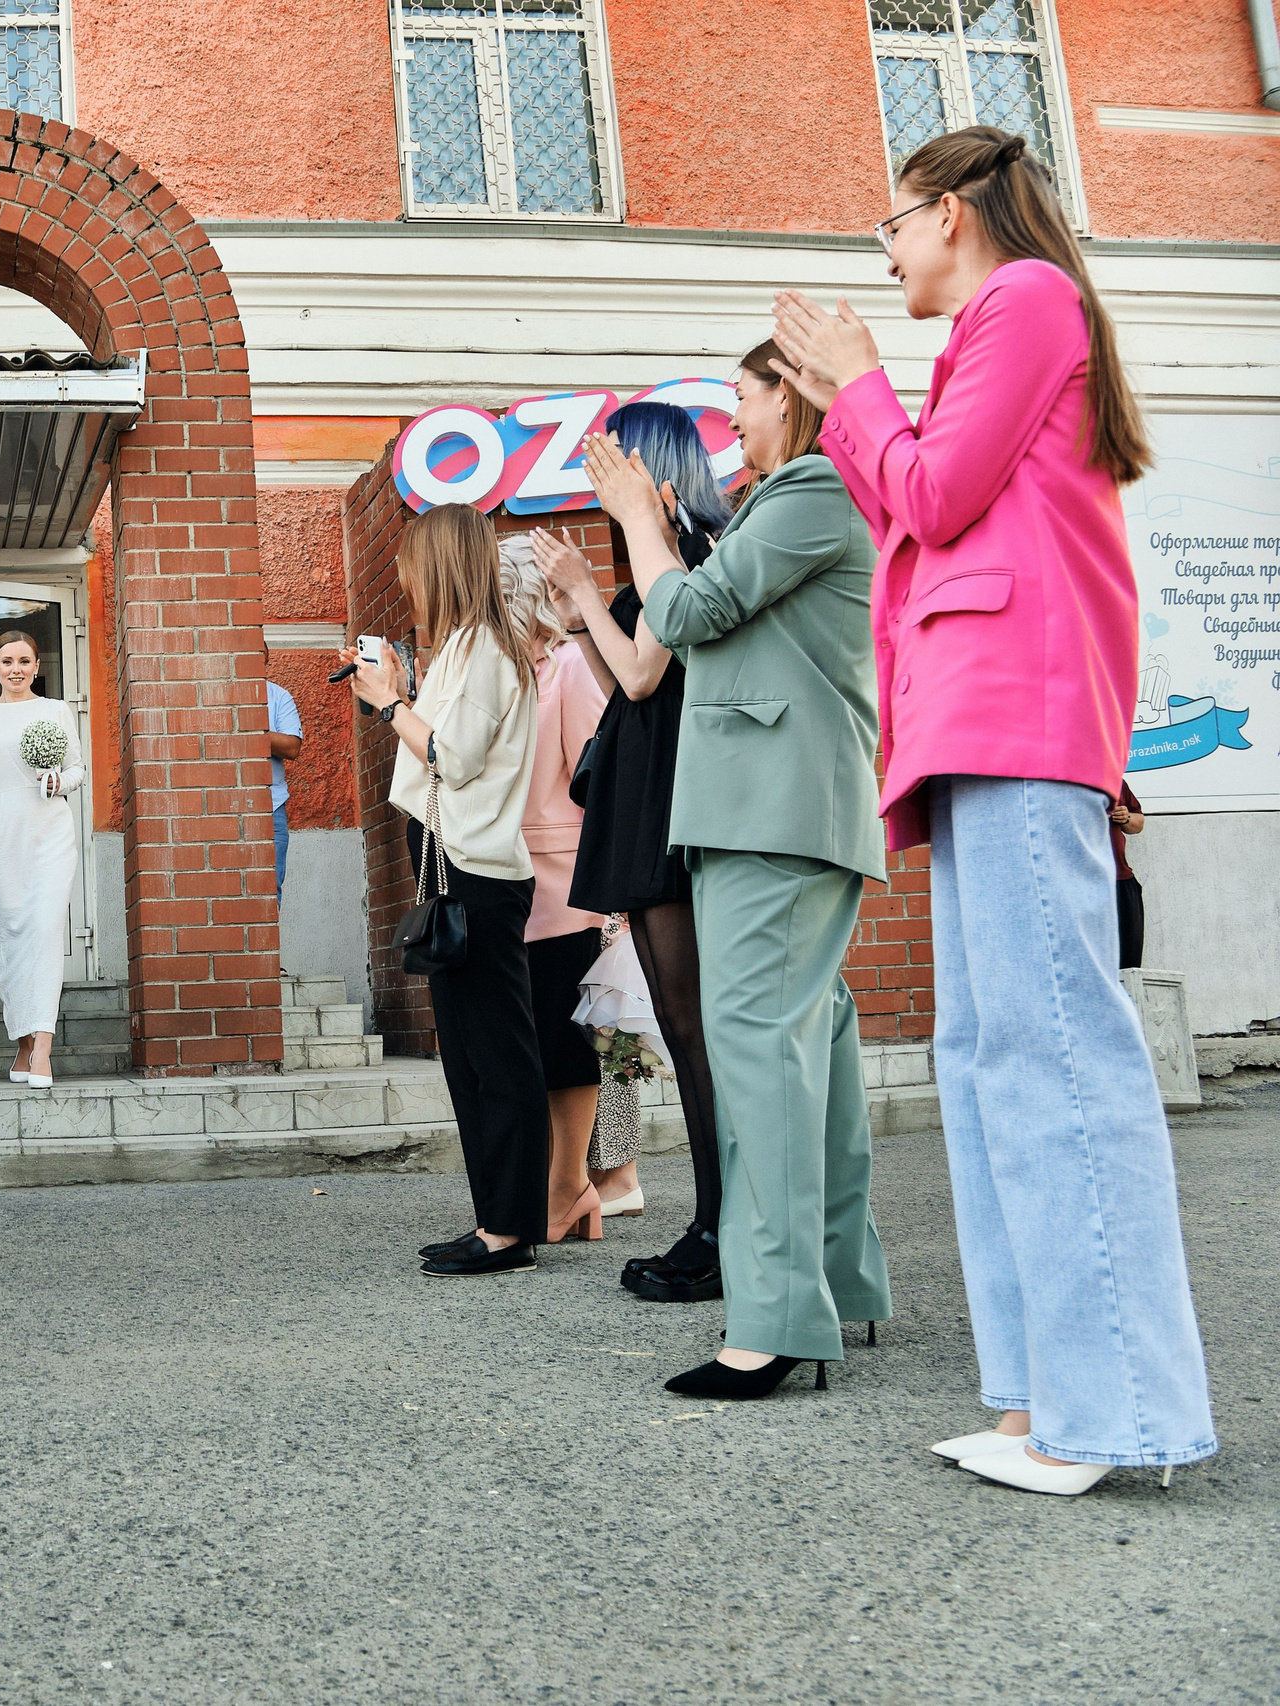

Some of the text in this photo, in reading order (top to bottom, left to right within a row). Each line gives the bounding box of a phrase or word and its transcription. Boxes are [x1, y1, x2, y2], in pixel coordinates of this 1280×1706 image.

[1150, 532, 1249, 556] Оформление
[1175, 560, 1280, 585] Свадебная пр
[1161, 588, 1226, 613] Товары
[1230, 593, 1259, 613] для
